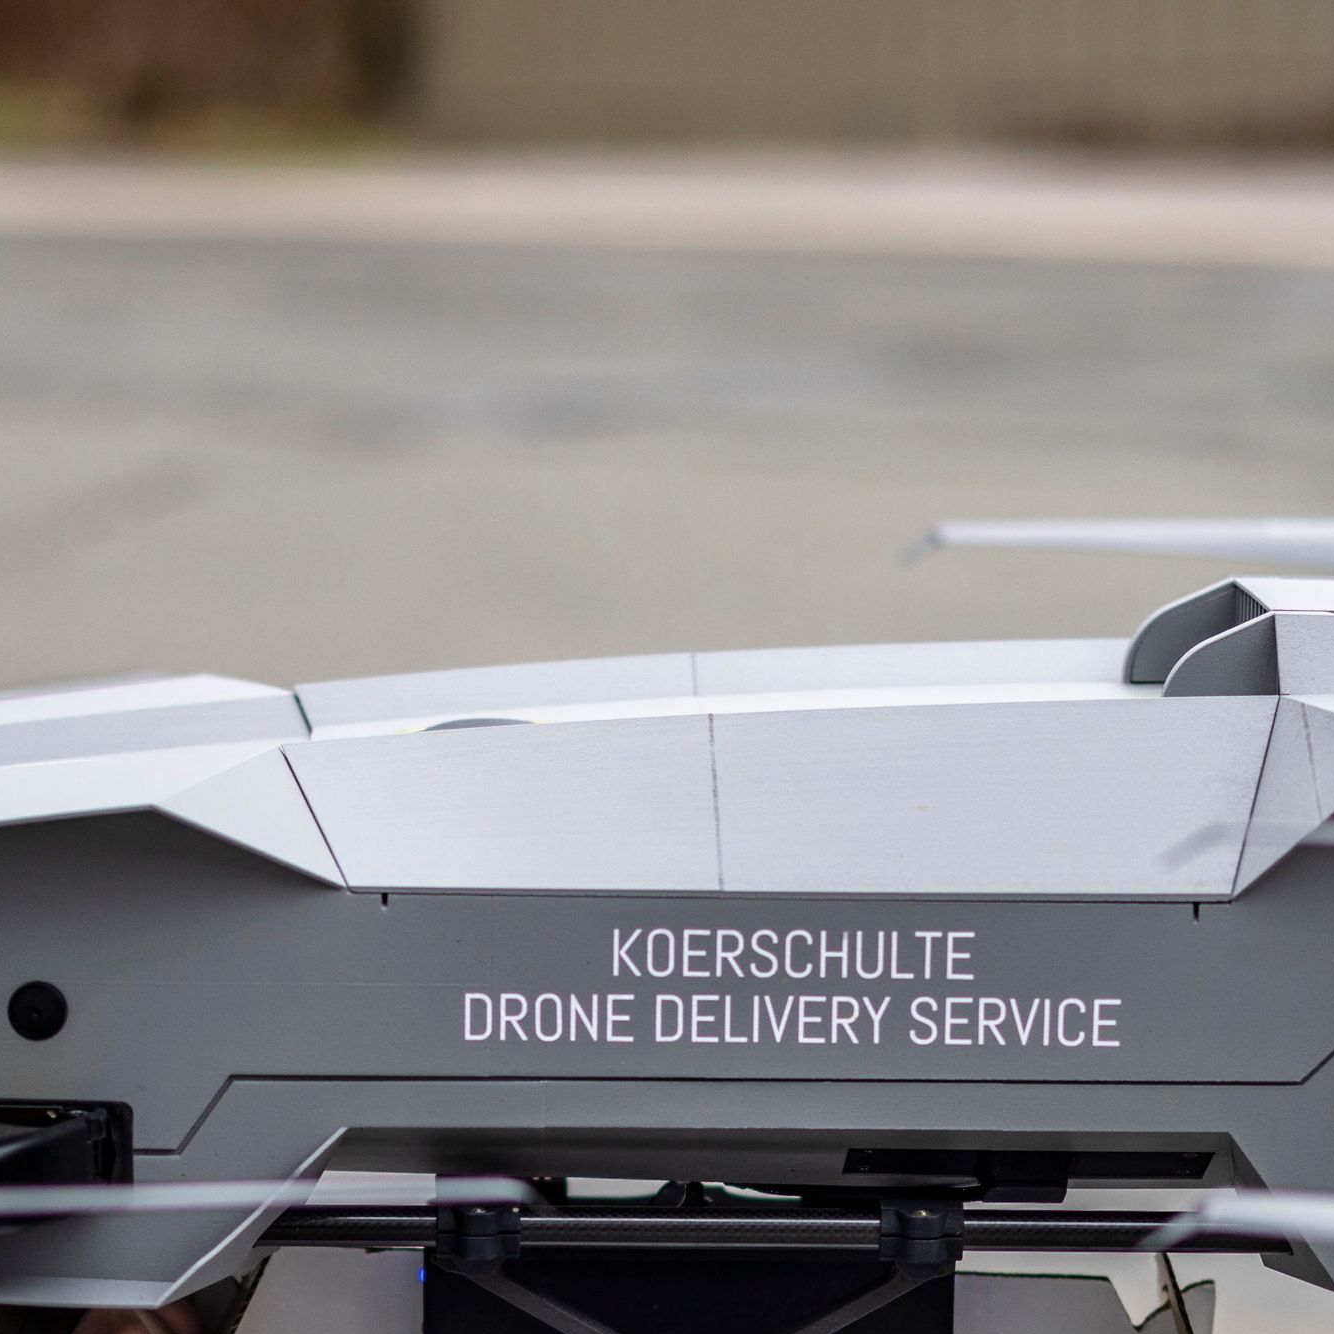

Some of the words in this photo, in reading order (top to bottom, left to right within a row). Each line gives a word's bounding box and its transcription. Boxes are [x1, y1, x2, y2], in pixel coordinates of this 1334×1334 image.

[612, 927, 976, 981] KOERSCHULTE
[463, 992, 635, 1043] DRONE
[654, 995, 891, 1045] DELIVERY
[907, 997, 1122, 1047] SERVICE
